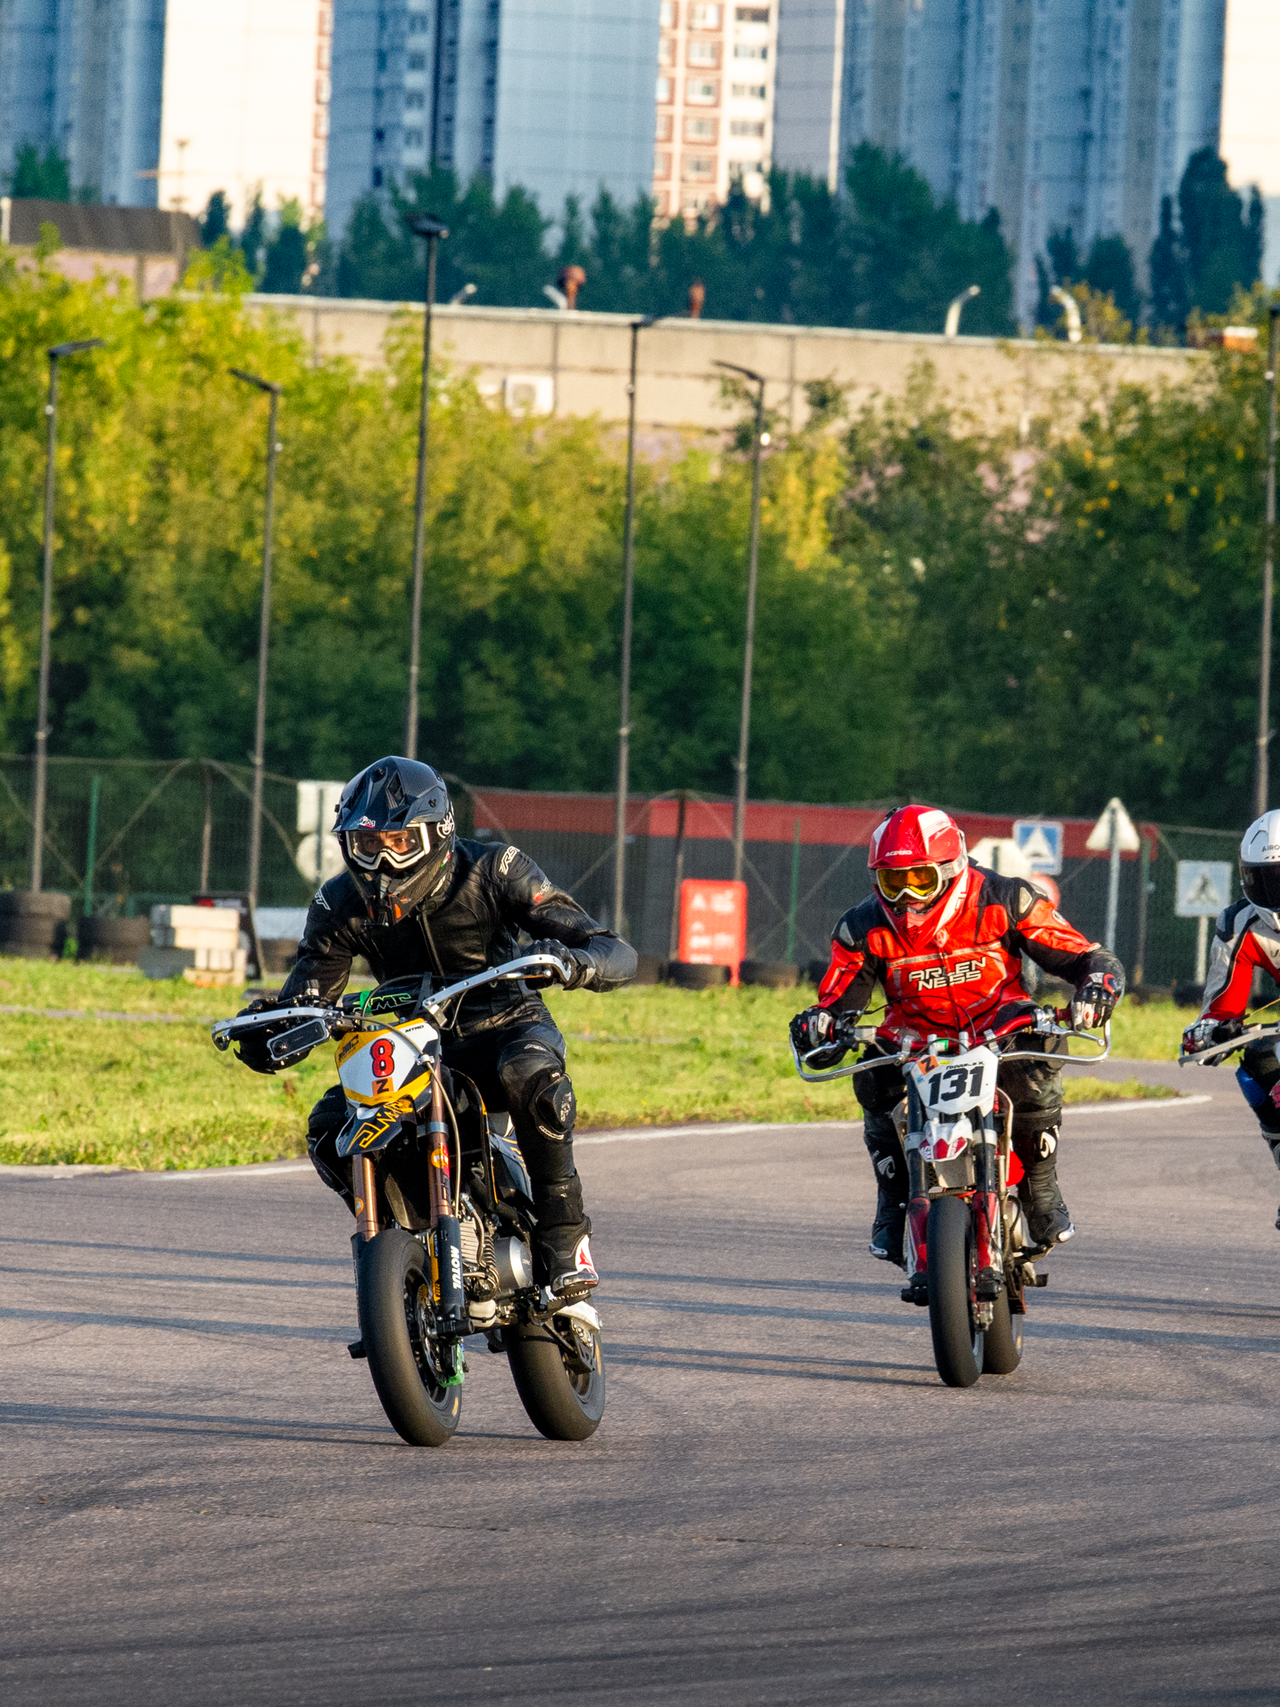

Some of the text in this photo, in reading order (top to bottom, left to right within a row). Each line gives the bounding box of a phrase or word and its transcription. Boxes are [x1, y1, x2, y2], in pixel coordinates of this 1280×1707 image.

[908, 956, 986, 982] ARLEN
[917, 970, 982, 991] NESS
[371, 1038, 395, 1078] 8
[928, 1066, 984, 1107] 131
[450, 1245, 461, 1290] MOTUL
